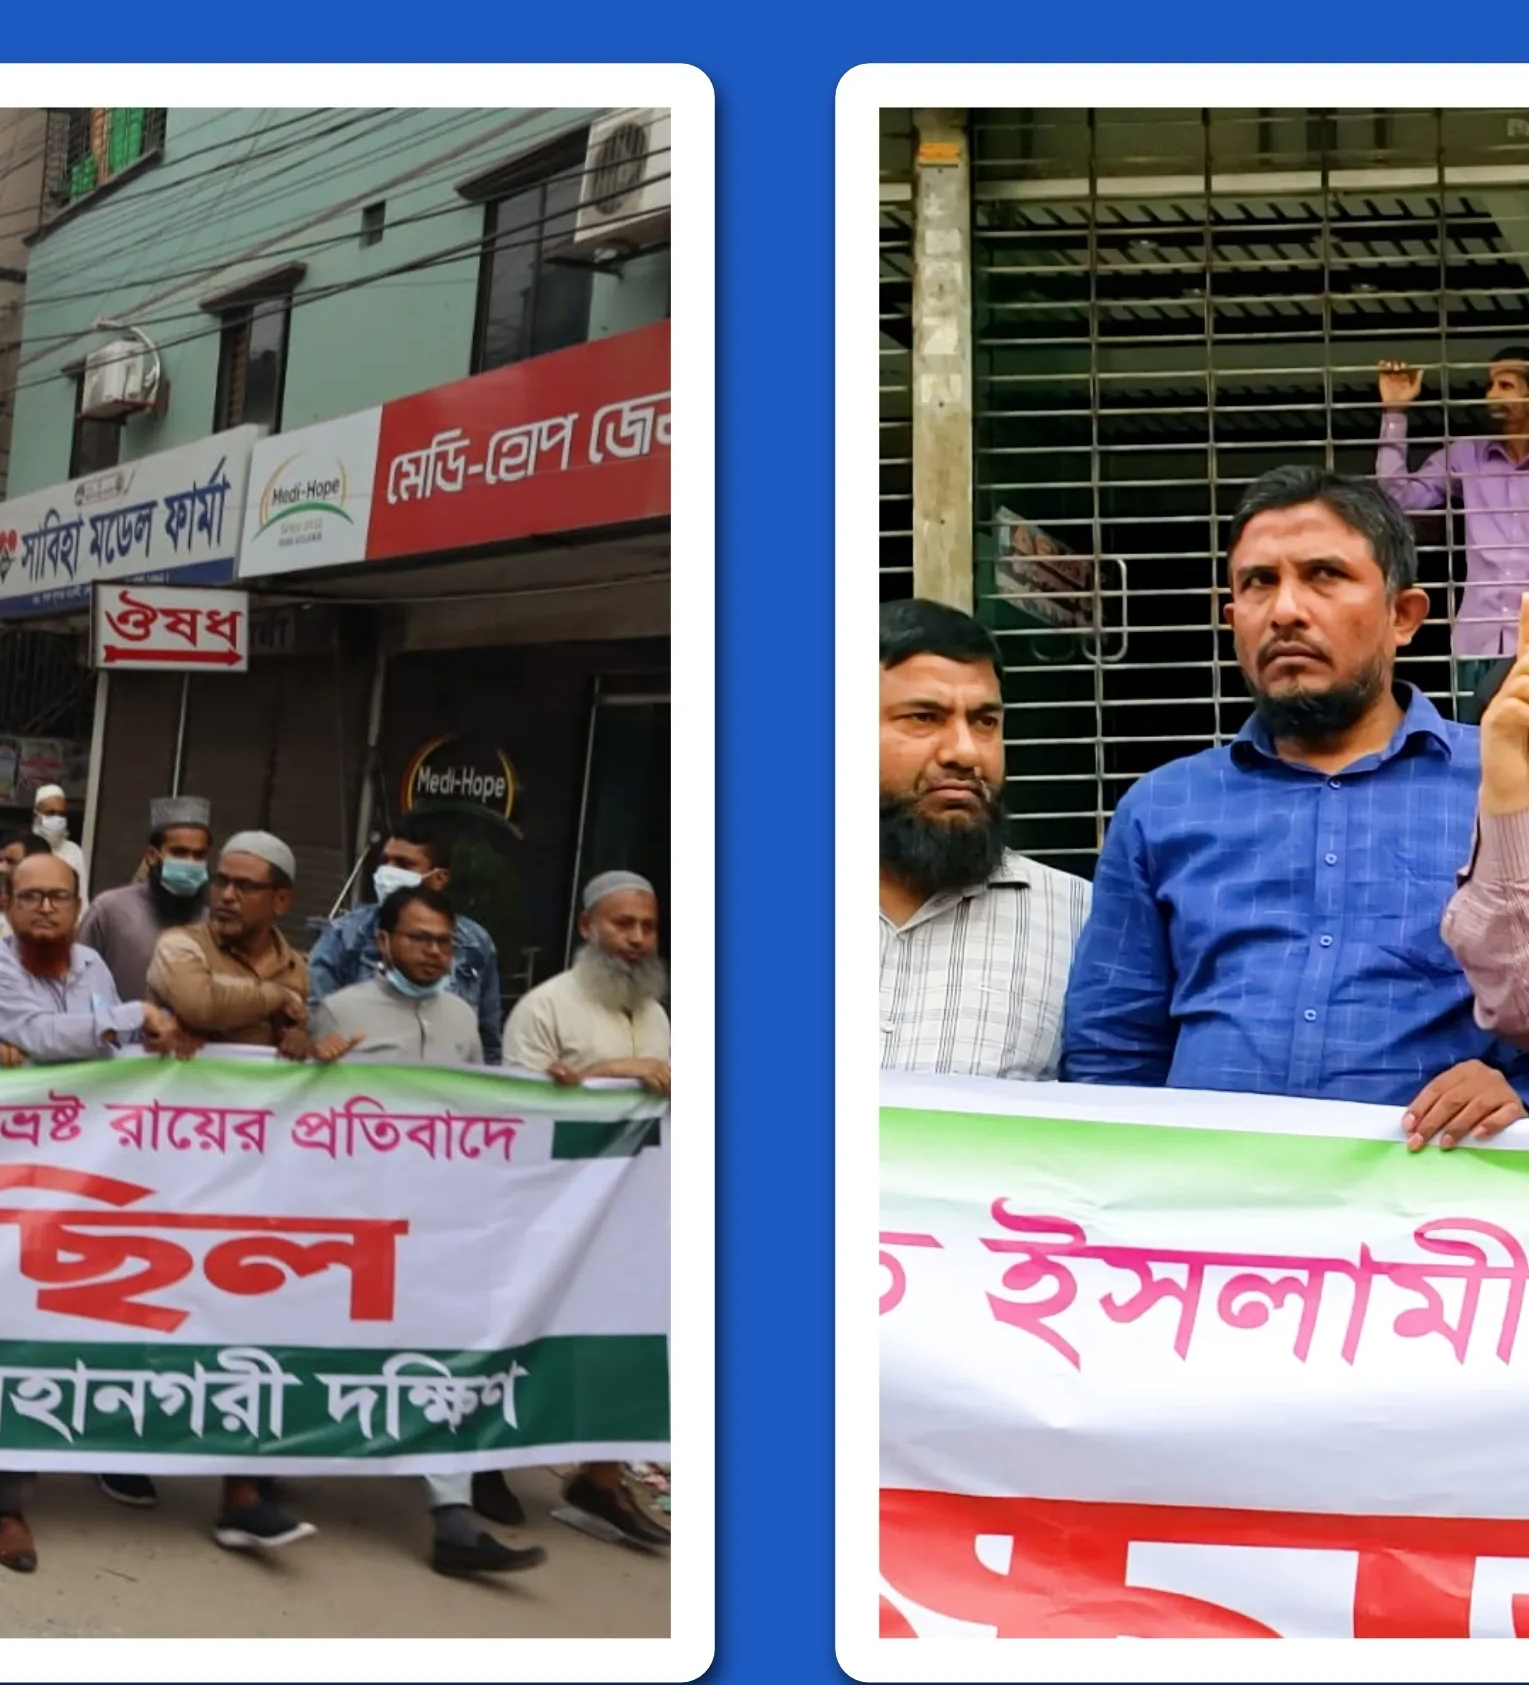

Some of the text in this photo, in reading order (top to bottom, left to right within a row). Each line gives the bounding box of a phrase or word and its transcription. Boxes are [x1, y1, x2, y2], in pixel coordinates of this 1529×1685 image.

[271, 475, 341, 506] Medi-Hope
[386, 410, 580, 507] মেডি-হোপ
[20, 456, 232, 584] সাবিহা মডেল ফার্মা
[105, 590, 242, 653] ঔষধ
[416, 764, 506, 803] Medi-Hope
[105, 1097, 276, 1155] রায়ের
[290, 1095, 525, 1163] প্রতিবাদে
[315, 1351, 529, 1441] দক্ষিণ
